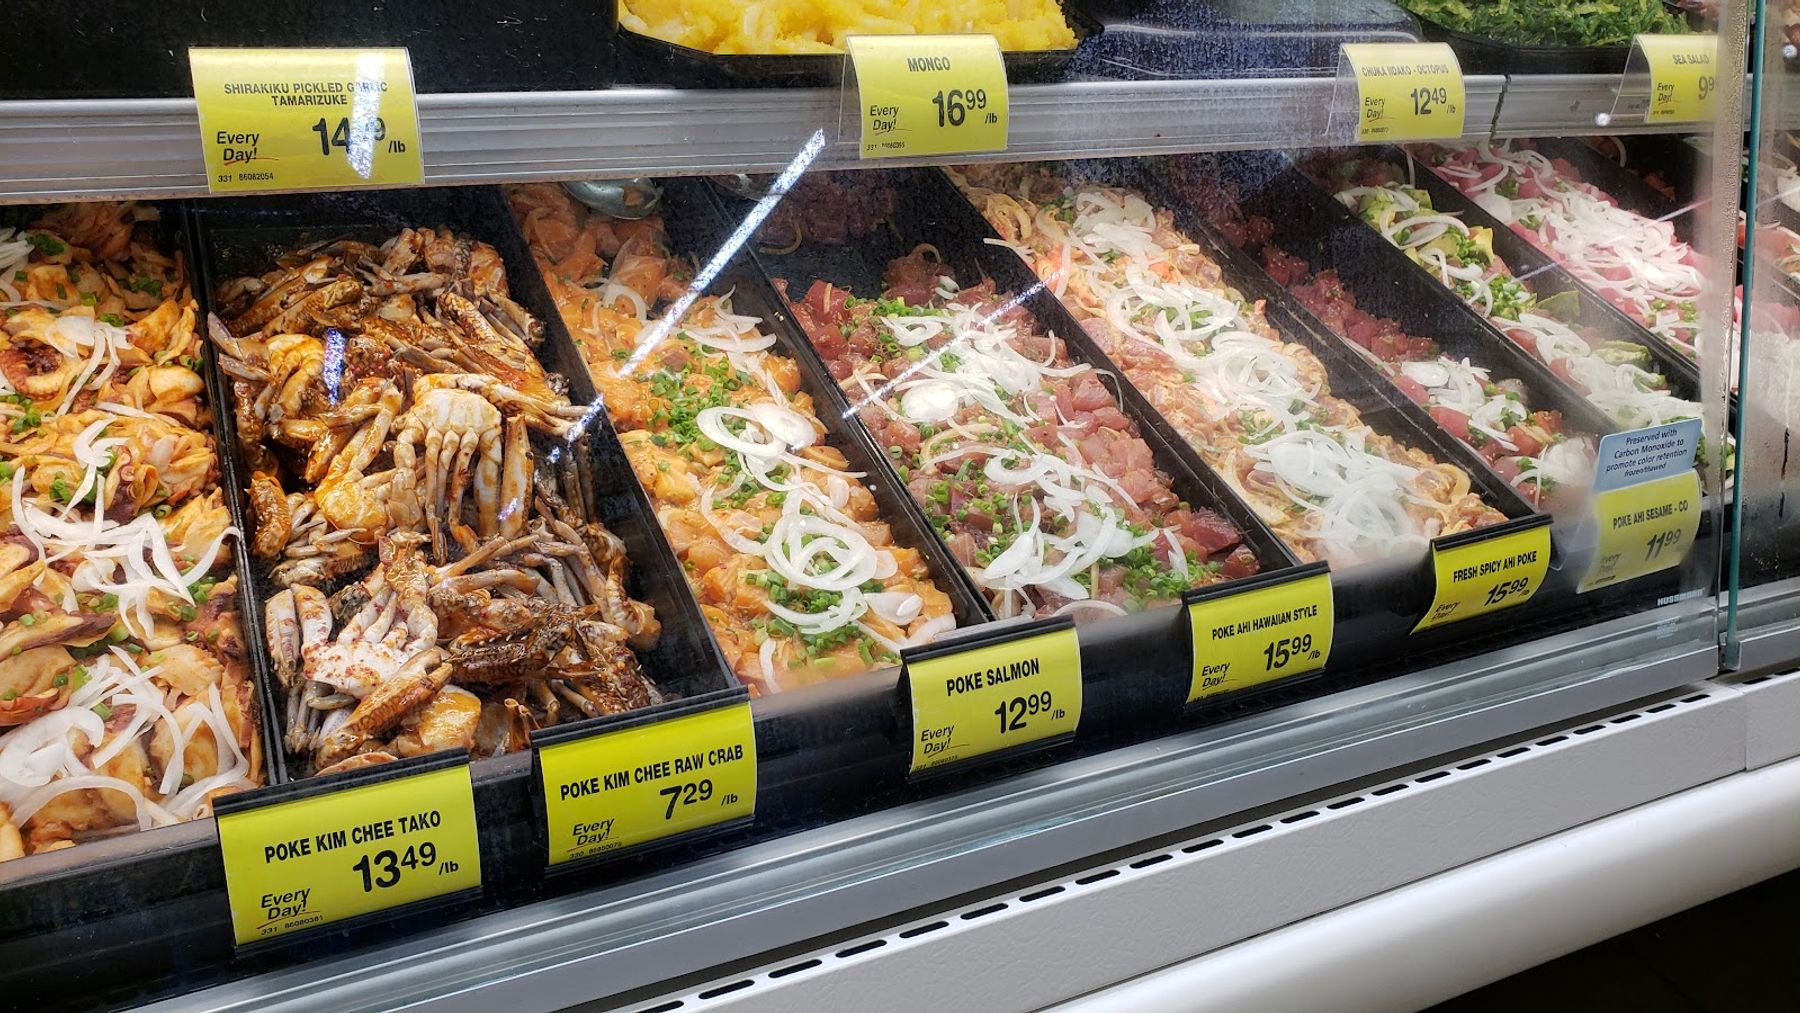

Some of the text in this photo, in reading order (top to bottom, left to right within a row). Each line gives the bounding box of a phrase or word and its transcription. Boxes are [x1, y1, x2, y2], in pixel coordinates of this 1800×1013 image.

[907, 57, 951, 72] MONGO
[1672, 54, 1687, 65] SEA
[1362, 65, 1387, 77] CHUKA
[1417, 64, 1449, 74] OCTOPUS
[224, 82, 388, 94] SHIRAKIKU PICKLED GRC
[1657, 83, 1675, 94] Every
[272, 95, 348, 106] TAMARIZUKE
[1364, 96, 1386, 109] Every
[870, 105, 899, 118] Every
[1366, 108, 1384, 120] Day!
[1447, 104, 1456, 114] /lb
[984, 112, 998, 124] /lb
[872, 119, 897, 133] Day!
[217, 131, 260, 146] Every
[388, 141, 406, 153] /lb
[223, 148, 257, 164] Day!
[1625, 428, 1678, 446] Preserved with
[1614, 438, 1684, 459] Carbon Monoxide to
[1606, 448, 1688, 473] promote color retention
[1613, 515, 1632, 530] POKE
[1633, 511, 1645, 525] AHI
[1646, 503, 1673, 520] SESAME
[1678, 500, 1689, 512] CO
[1453, 550, 1537, 583] FRESH SPICY AHI POKE
[1435, 601, 1461, 614] Every
[1212, 604, 1317, 640] POKE AHI HAWAIIAN STYLE
[1307, 650, 1321, 660] /lb
[1202, 662, 1231, 676] Every
[946, 658, 1040, 696] POKE SALMON
[1202, 673, 1226, 688] Day!
[1051, 709, 1065, 721] /lb
[921, 725, 955, 742] Every
[923, 737, 951, 755] Day!
[560, 744, 744, 800] POKE KIM CHEE RAW CRAB
[720, 794, 738, 807] /lb
[572, 818, 615, 836] Every
[264, 810, 441, 864] POKE KIM CHEE TAKO
[576, 828, 611, 847] Day!
[438, 860, 459, 876] /lb
[261, 888, 311, 908] Every
[267, 900, 307, 921] Day!
[261, 926, 278, 936] 331
